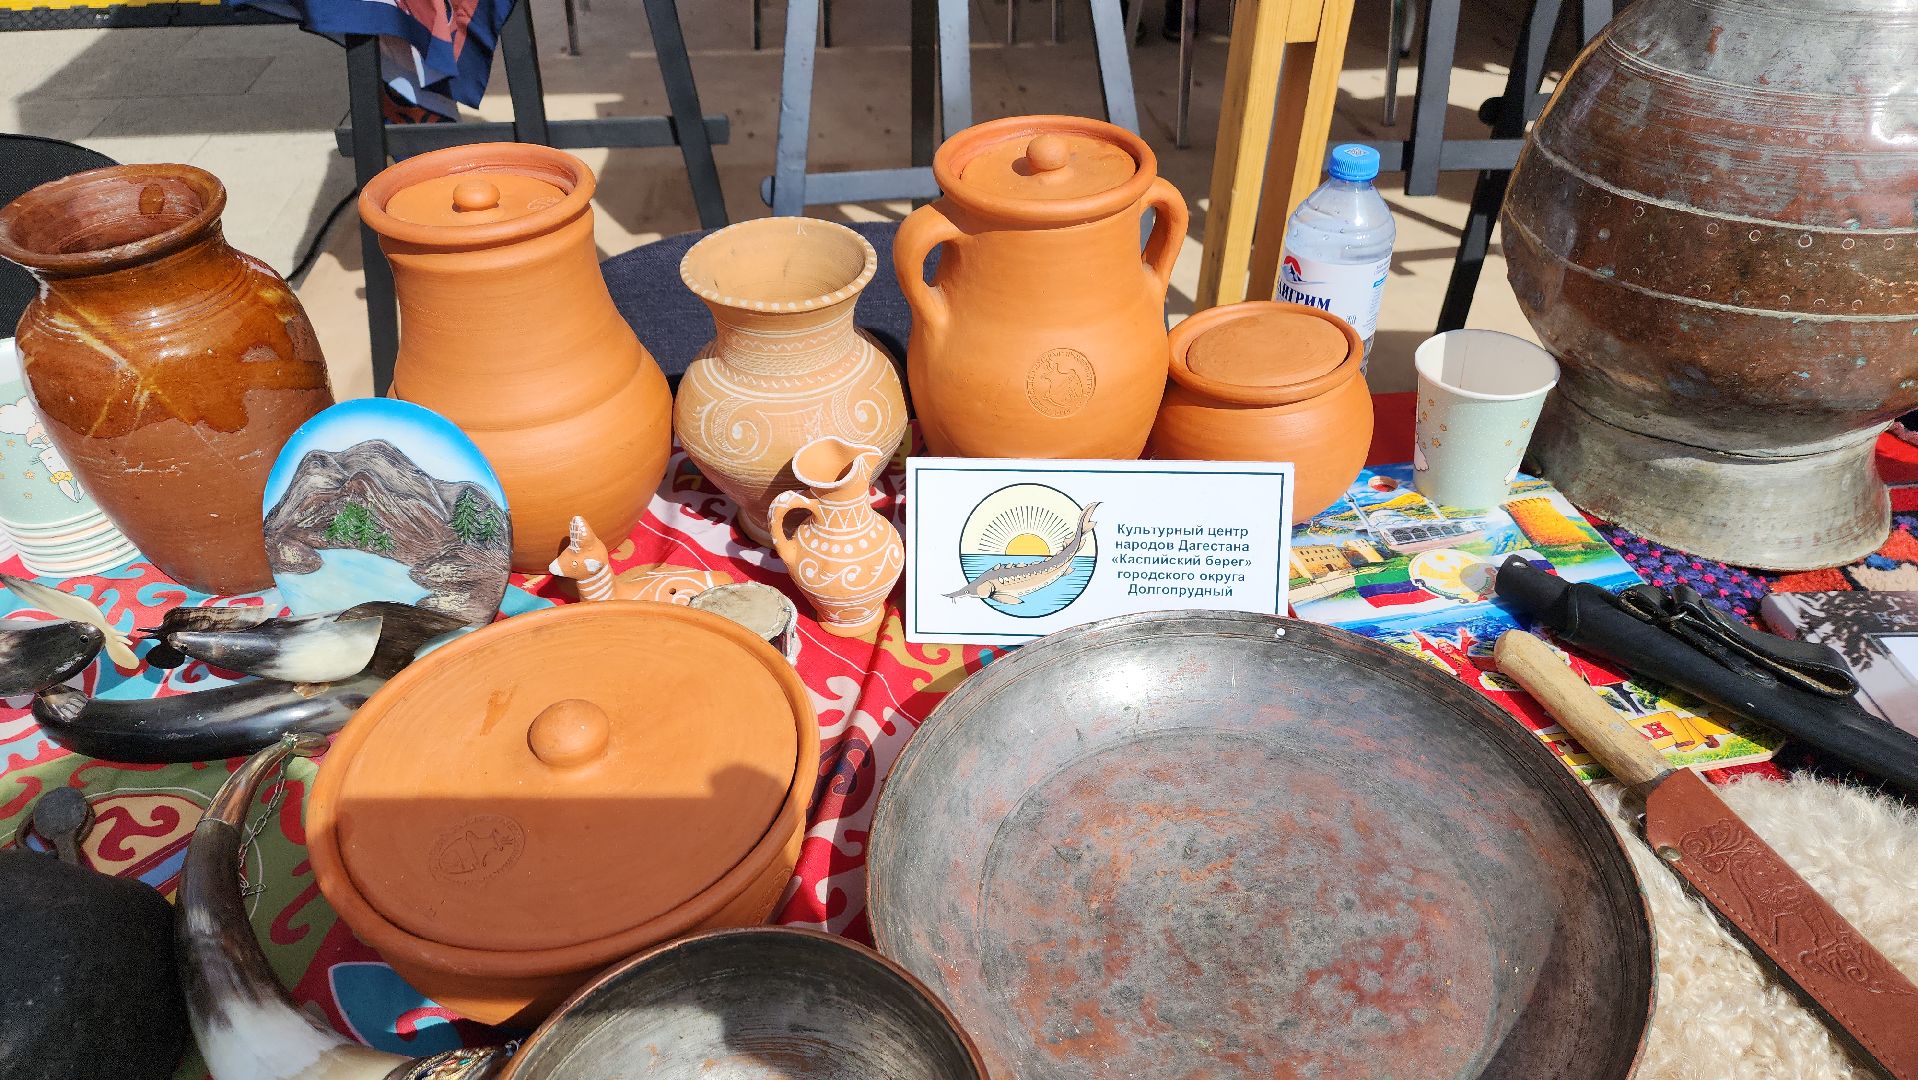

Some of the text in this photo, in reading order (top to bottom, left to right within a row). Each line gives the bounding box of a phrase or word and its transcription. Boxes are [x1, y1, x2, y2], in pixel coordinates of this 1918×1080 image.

[1117, 523, 1249, 539] Культурный центр
[1115, 539, 1250, 553] народов Дагестана
[1111, 553, 1252, 568] «Каспийский берег»
[1117, 570, 1245, 585] городского округа
[1127, 583, 1233, 599] Долгопрудный
